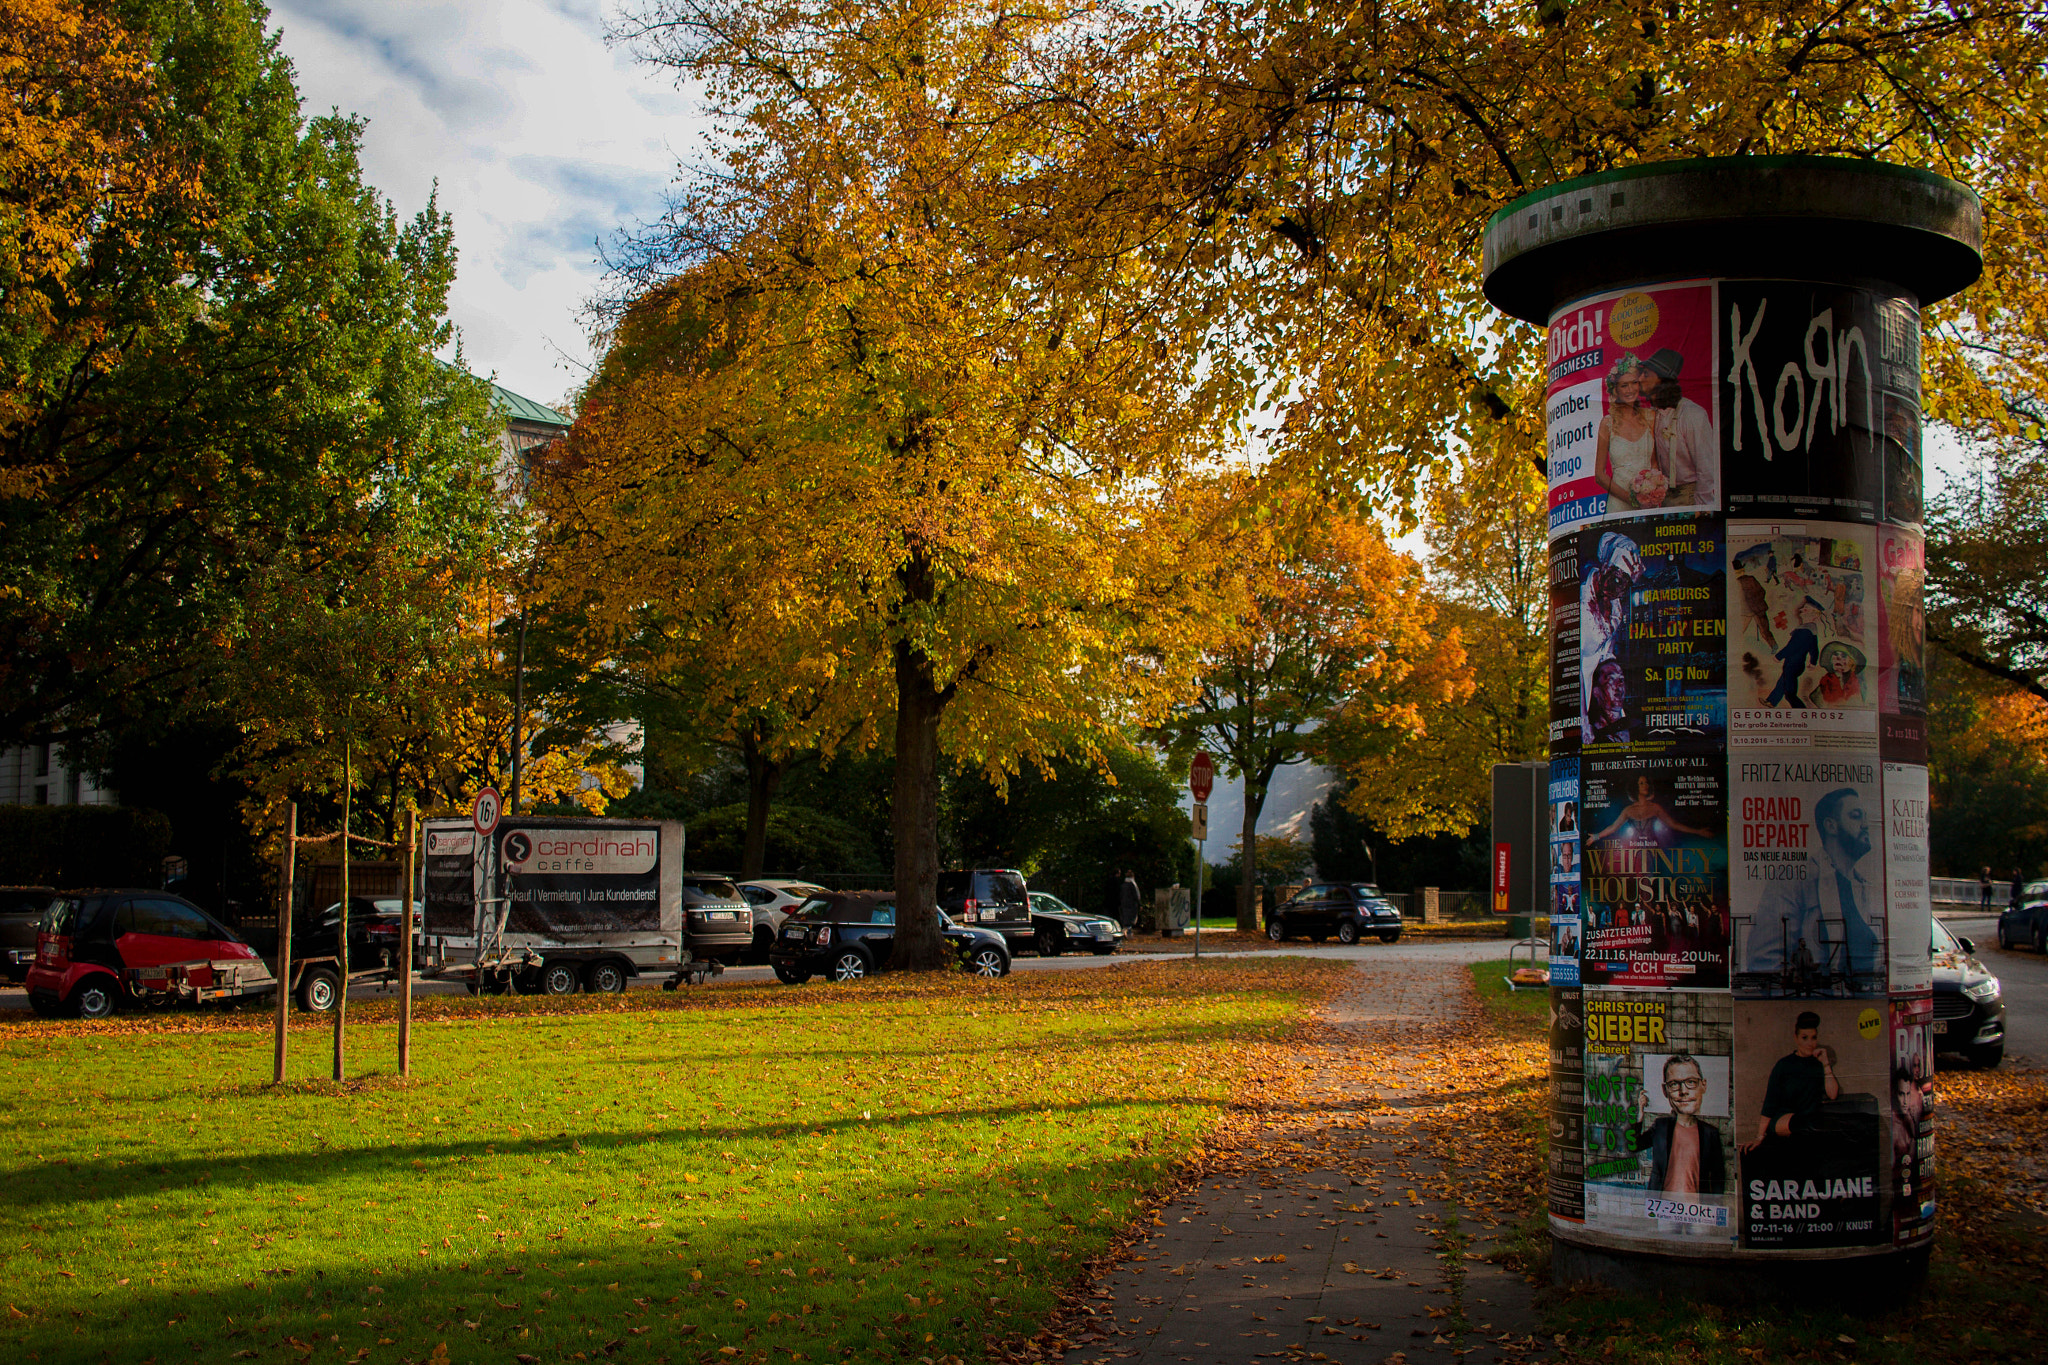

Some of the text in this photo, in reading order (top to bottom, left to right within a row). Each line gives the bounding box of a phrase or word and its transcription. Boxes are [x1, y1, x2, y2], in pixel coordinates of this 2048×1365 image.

[1556, 421, 1593, 450] Airport
[1554, 456, 1581, 478] Tango
[1655, 524, 1696, 539] HORROR
[1640, 541, 1714, 558] HOSPITAL 36
[1644, 587, 1710, 602] HAMBURGS
[1658, 641, 1693, 655] PARTY
[1666, 667, 1683, 681] 05
[1651, 714, 1693, 726] FREIHEIT
[1697, 713, 1710, 725] 36
[1734, 711, 1844, 720] GEORGE GROSZ
[1591, 757, 1708, 771] THE GREATEST LOVE OF ALL
[1192, 766, 1211, 788] STOP
[1742, 763, 1874, 784] FRITZ KALKBRENNER
[1742, 797, 1801, 821] GRAND
[1892, 799, 1924, 818] KATIE
[1743, 821, 1809, 848] DÉPART
[538, 837, 654, 856] cardinahl
[1604, 839, 1621, 848] THE
[538, 857, 594, 871] caffè
[1586, 848, 1719, 874] WHITNEY
[1743, 852, 1807, 861] DAS NEUE ALBUM
[1745, 864, 1807, 881] 14.10.2016
[505, 888, 656, 904] erkauf Vermietung Jura Kundendienst
[1587, 877, 1715, 903] HOUSTON
[1679, 886, 1709, 896] SHOW
[1586, 926, 1652, 940] ZUSATZTERMIN
[1585, 949, 1629, 963] 22.11.16,
[1630, 950, 1680, 964] Hamburg,
[1632, 962, 1658, 974] CCH
[1587, 1001, 1666, 1014] CHRISTOPH
[1587, 1013, 1666, 1044] SIEBER
[1859, 1018, 1880, 1030] LIVE
[1588, 1043, 1630, 1054] Kabarett
[1588, 1074, 1637, 1102] HOFF
[1750, 1177, 1874, 1201] SARAJANE
[1750, 1203, 1821, 1220] & BAND
[1751, 1224, 1793, 1233] 07-11-16
[1807, 1223, 1834, 1232] 21:00
[1846, 1220, 1873, 1231] KNUST
